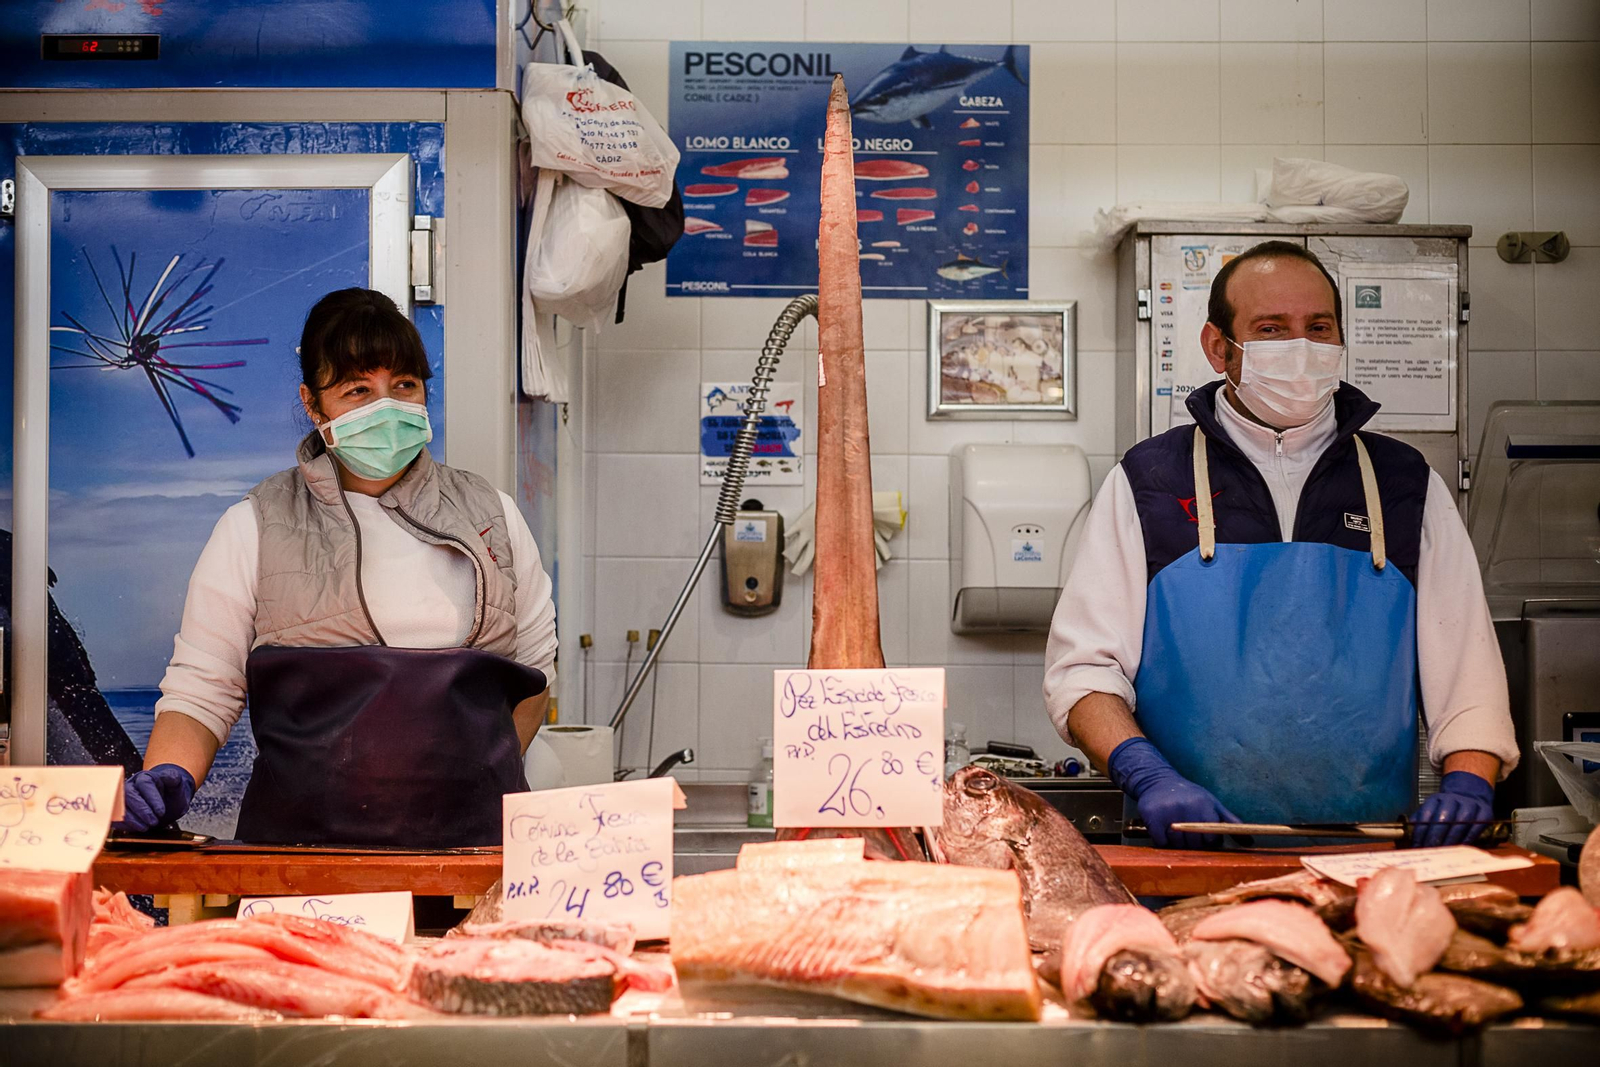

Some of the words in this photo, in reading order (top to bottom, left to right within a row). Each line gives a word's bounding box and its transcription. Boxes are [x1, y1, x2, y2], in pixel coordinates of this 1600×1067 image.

[685, 52, 833, 76] PESCONIL
[684, 93, 713, 102] CONIL
[959, 97, 1003, 108] CABEZA
[685, 136, 729, 149] LOMO
[732, 137, 790, 149] BLANCO
[817, 138, 861, 151] LO
[865, 138, 913, 151] NEGRO
[682, 281, 730, 291] PESCONIL
[1176, 386, 1195, 394] 2020
[915, 751, 935, 775] €
[603, 871, 634, 898] 80
[641, 861, 664, 886] €
